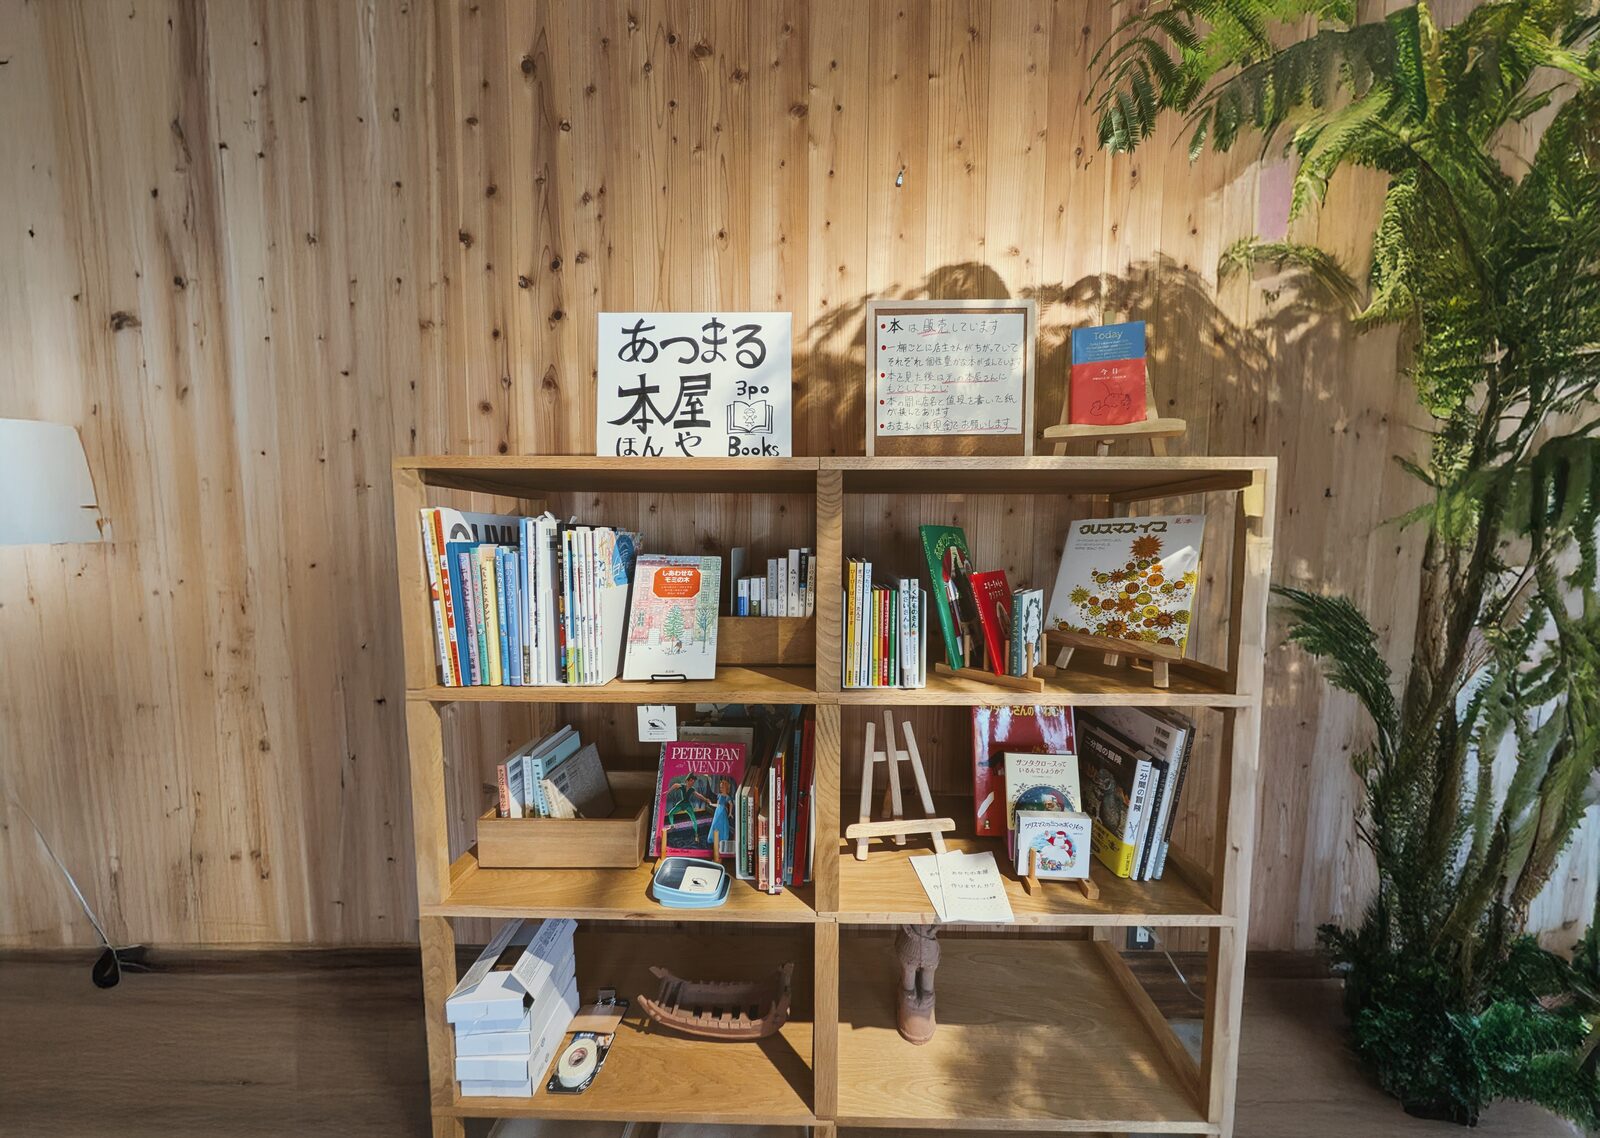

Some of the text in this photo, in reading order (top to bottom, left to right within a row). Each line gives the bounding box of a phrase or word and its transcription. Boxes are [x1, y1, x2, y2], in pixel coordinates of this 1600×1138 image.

[617, 317, 767, 369] あつまる
[1094, 330, 1124, 341] Today
[735, 380, 769, 400] 3po
[607, 372, 711, 435] 本屋
[728, 436, 780, 457] Books
[442, 578, 453, 619] オリビア
[671, 747, 740, 761] PETER PAN
[1016, 759, 1067, 768] サンタクロースって
[687, 760, 734, 773] WENDY
